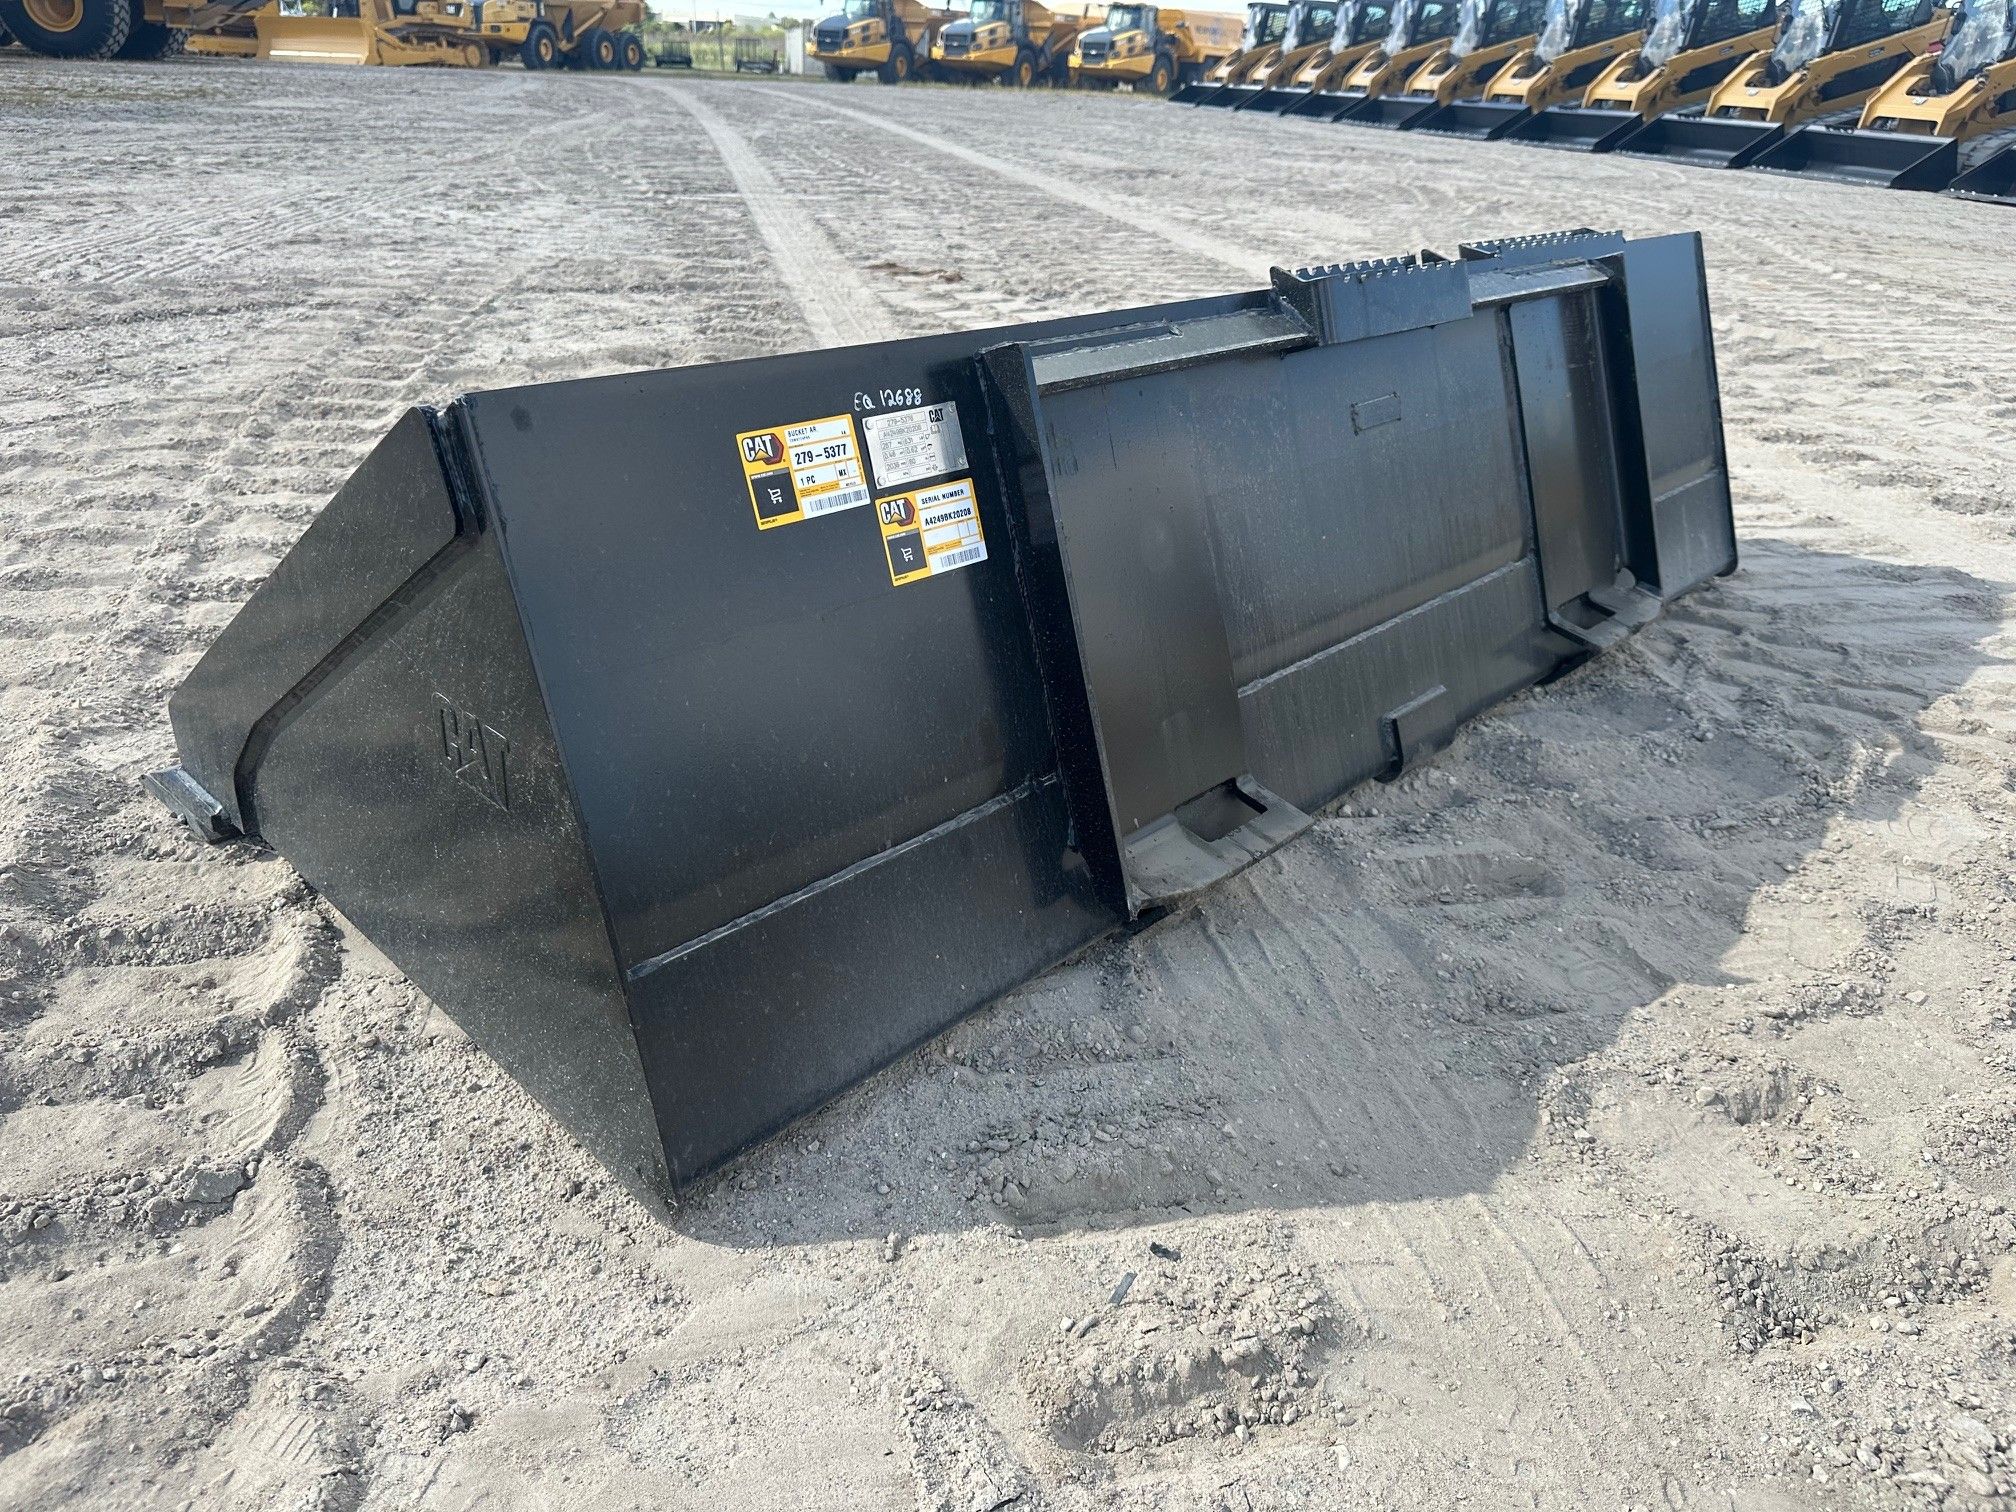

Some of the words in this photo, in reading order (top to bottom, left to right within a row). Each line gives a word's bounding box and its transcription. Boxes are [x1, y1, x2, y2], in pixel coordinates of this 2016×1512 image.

[880, 388, 922, 407] 12688
[928, 408, 944, 423] CAT
[788, 428, 808, 438] BUCKET
[742, 434, 773, 462] CAT
[838, 468, 847, 477] MX
[806, 476, 816, 486] PC
[921, 495, 940, 504] SERIAL
[942, 488, 964, 500] NUMBER
[880, 498, 906, 524] CAT
[431, 691, 510, 812] CAT
